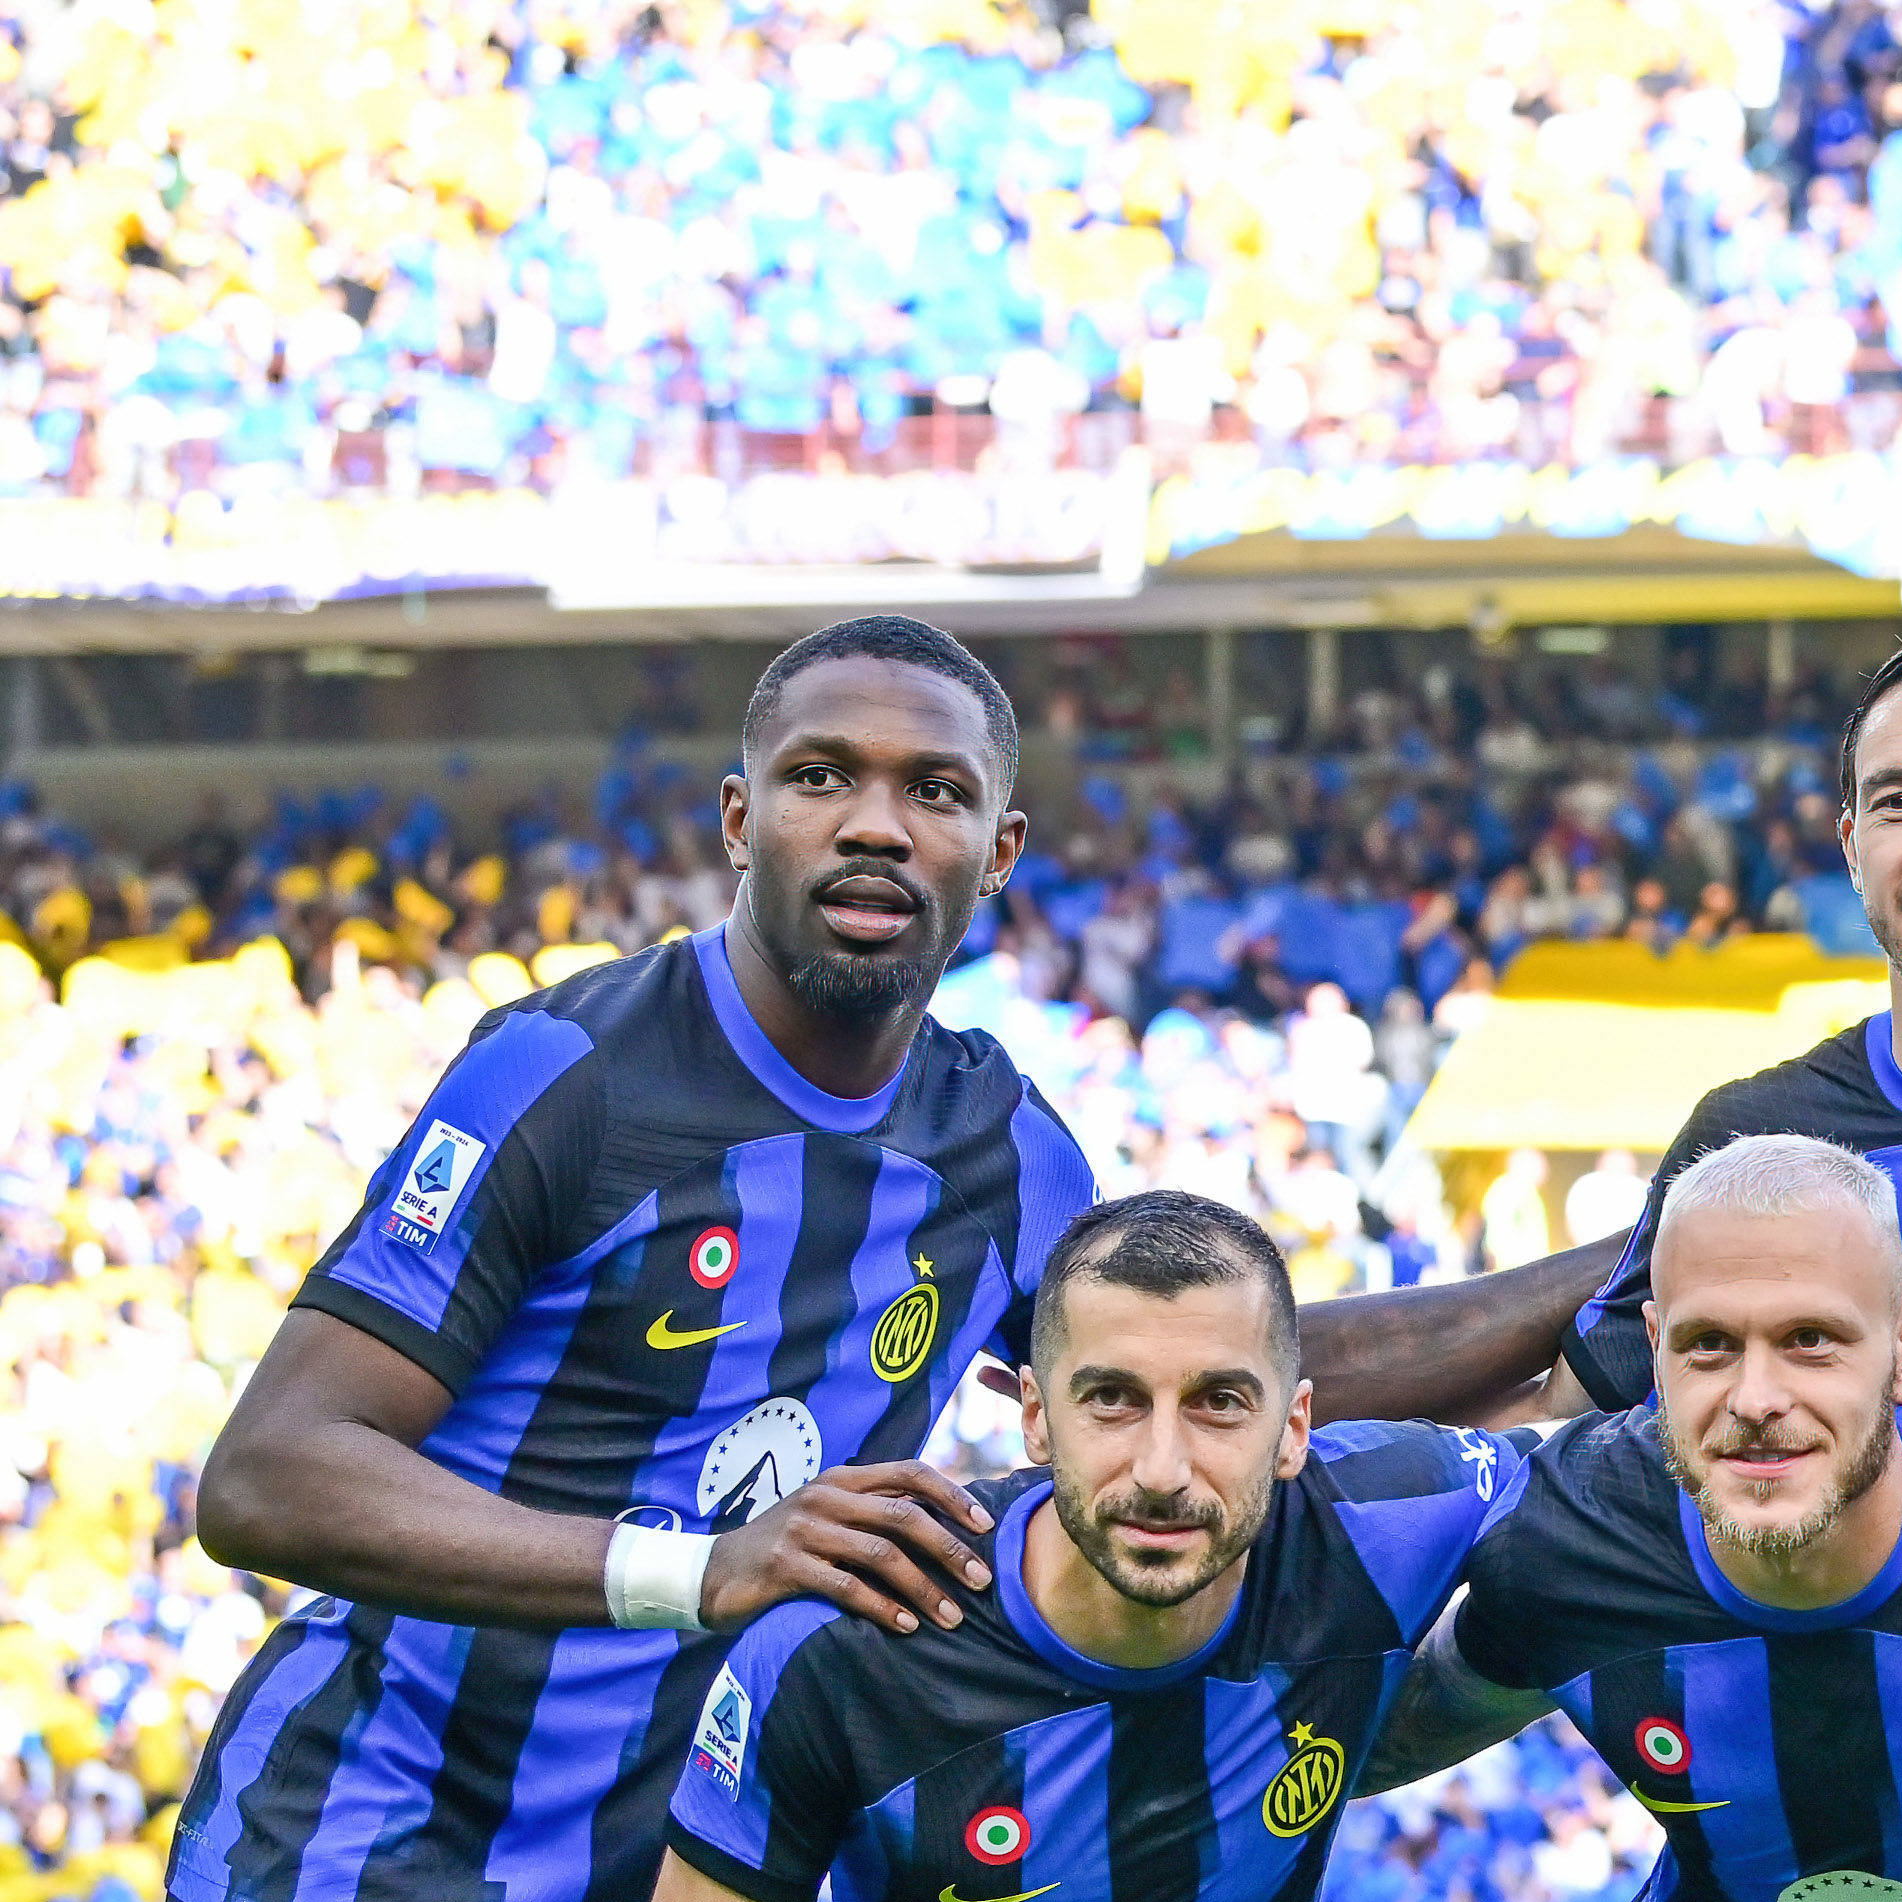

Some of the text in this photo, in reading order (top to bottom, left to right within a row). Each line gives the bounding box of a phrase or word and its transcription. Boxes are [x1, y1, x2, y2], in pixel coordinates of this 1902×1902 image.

[400, 1190, 438, 1219] SERIE A
[396, 1220, 428, 1247] TIM
[712, 1763, 736, 1792] TIM
